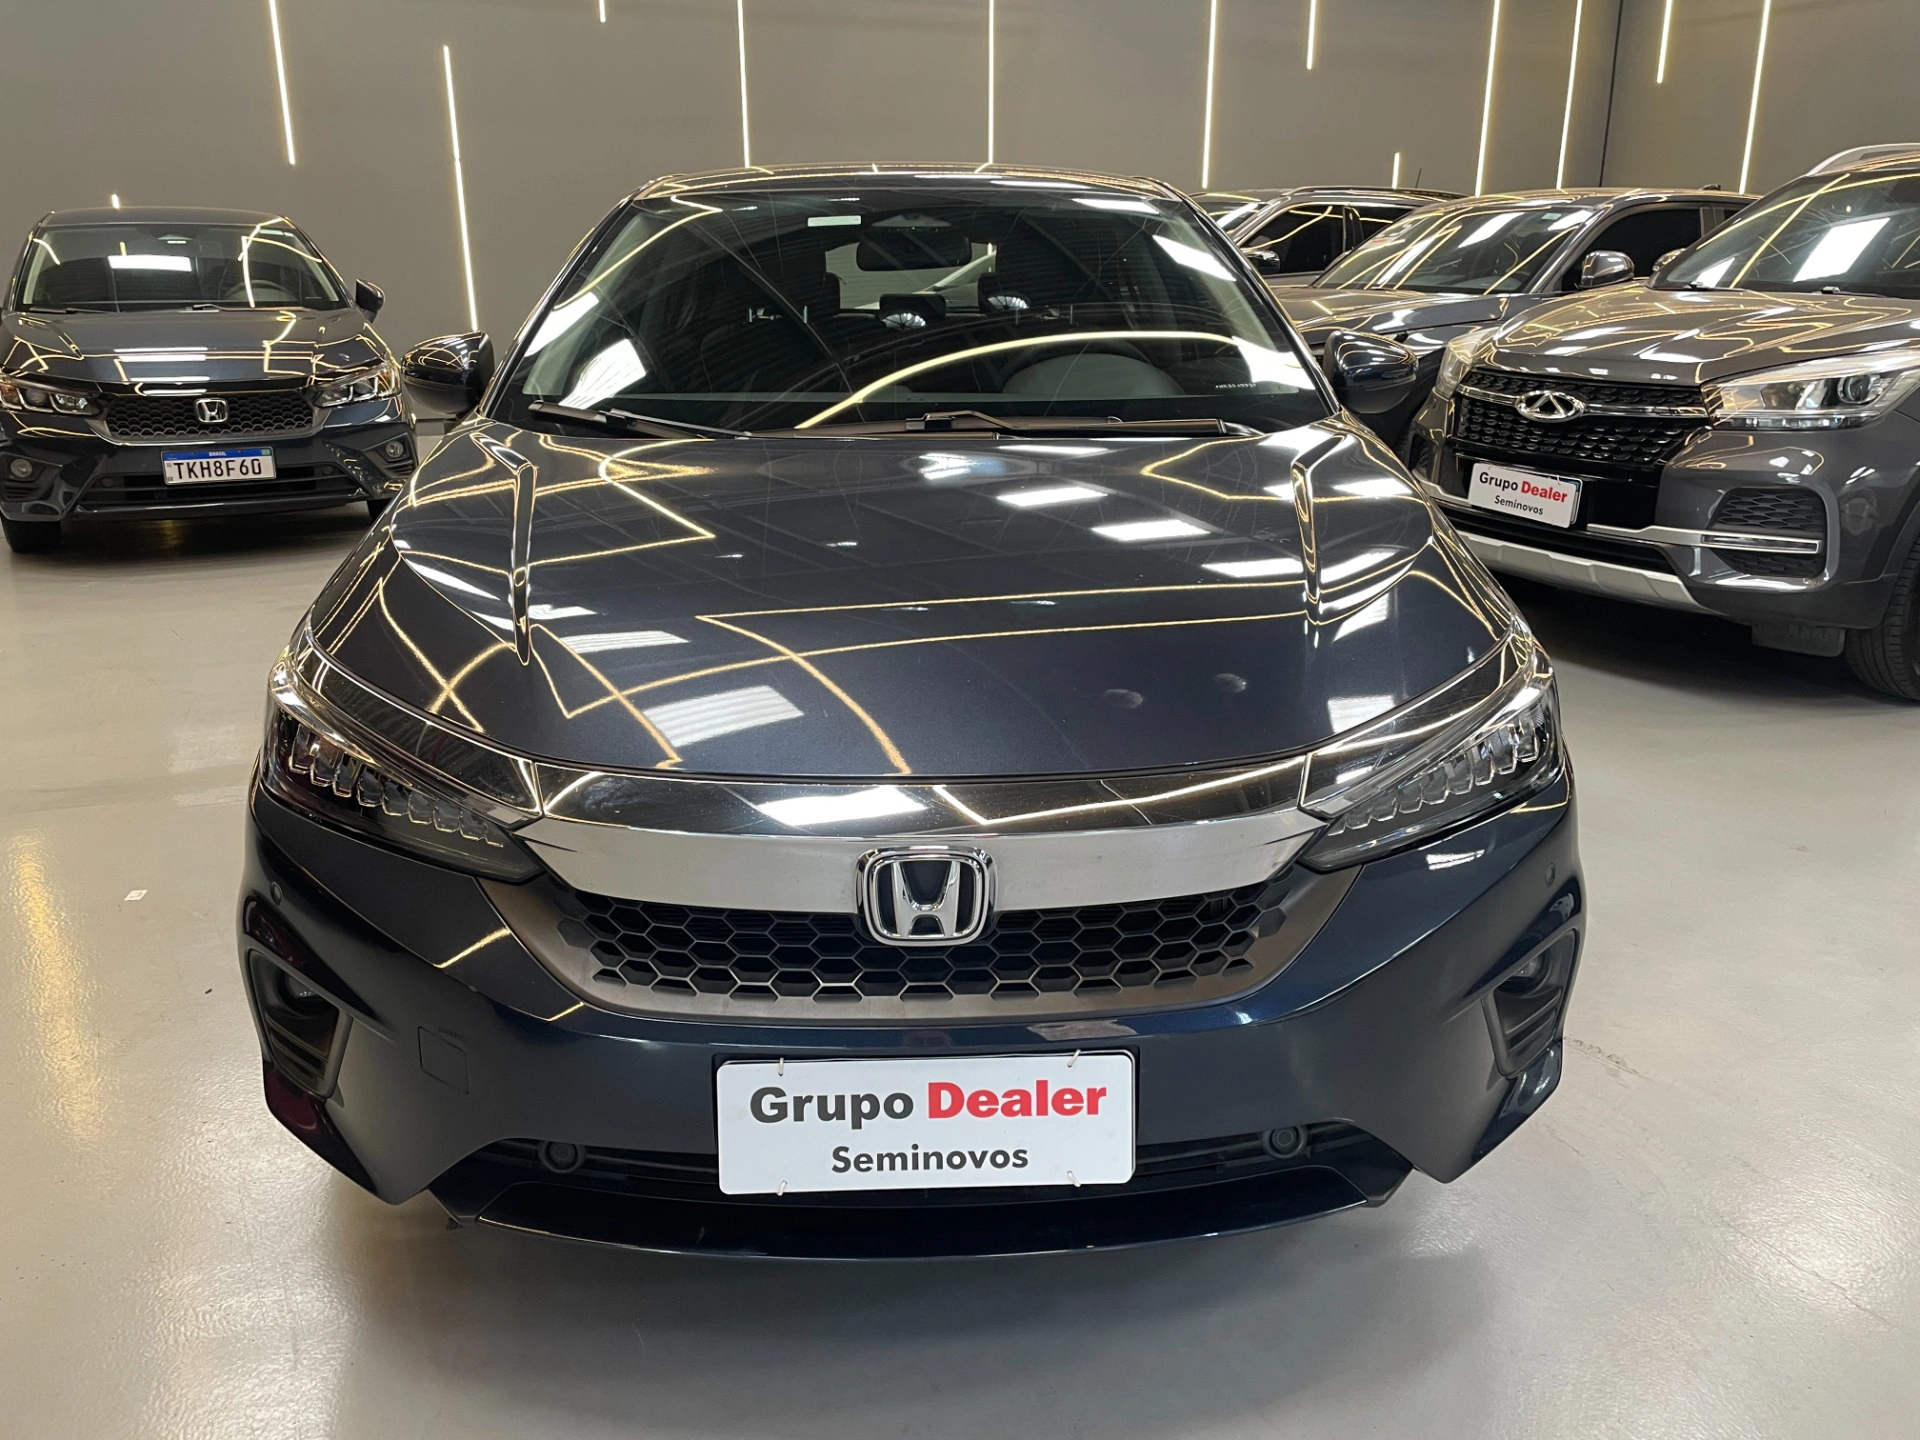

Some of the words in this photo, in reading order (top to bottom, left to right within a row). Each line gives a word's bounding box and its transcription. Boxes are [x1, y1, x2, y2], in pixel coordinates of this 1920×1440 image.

[174, 459, 262, 479] TKH8F60
[1479, 472, 1518, 491] Grupo
[1521, 481, 1568, 502] Dealer
[1494, 495, 1543, 515] Seminovos
[750, 1087, 914, 1130] Grupo
[928, 1079, 1107, 1119] Dealer
[832, 1144, 1029, 1174] Seminovos
